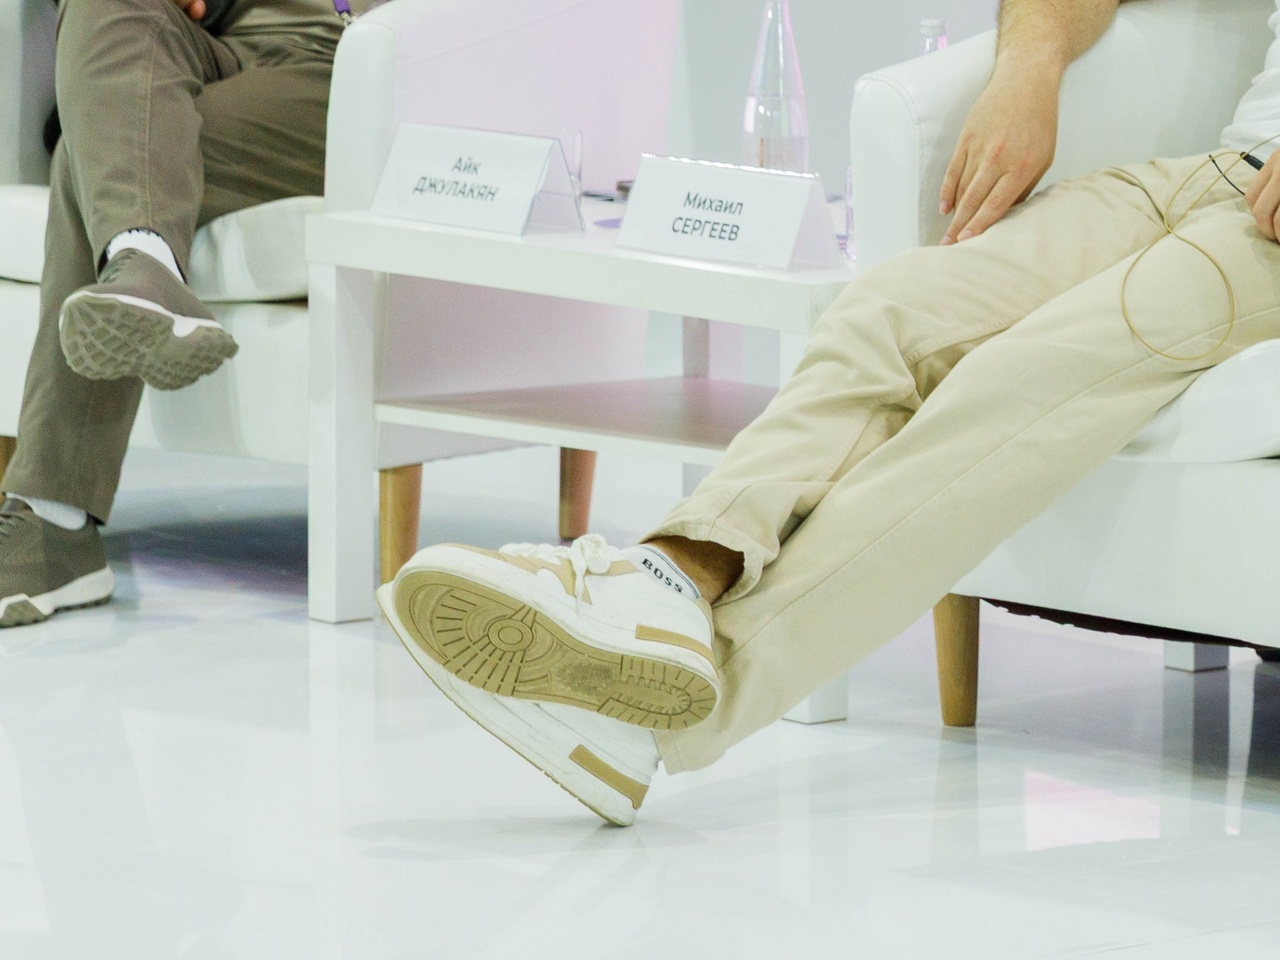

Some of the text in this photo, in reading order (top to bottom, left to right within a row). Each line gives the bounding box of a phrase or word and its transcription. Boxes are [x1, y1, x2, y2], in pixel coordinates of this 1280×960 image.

[451, 156, 481, 175] Айк
[412, 176, 499, 202] ДЖУЛАКЯН
[683, 191, 744, 215] Михаил
[672, 216, 740, 241] СЕРГЕЕВ
[642, 558, 683, 593] BOSS
